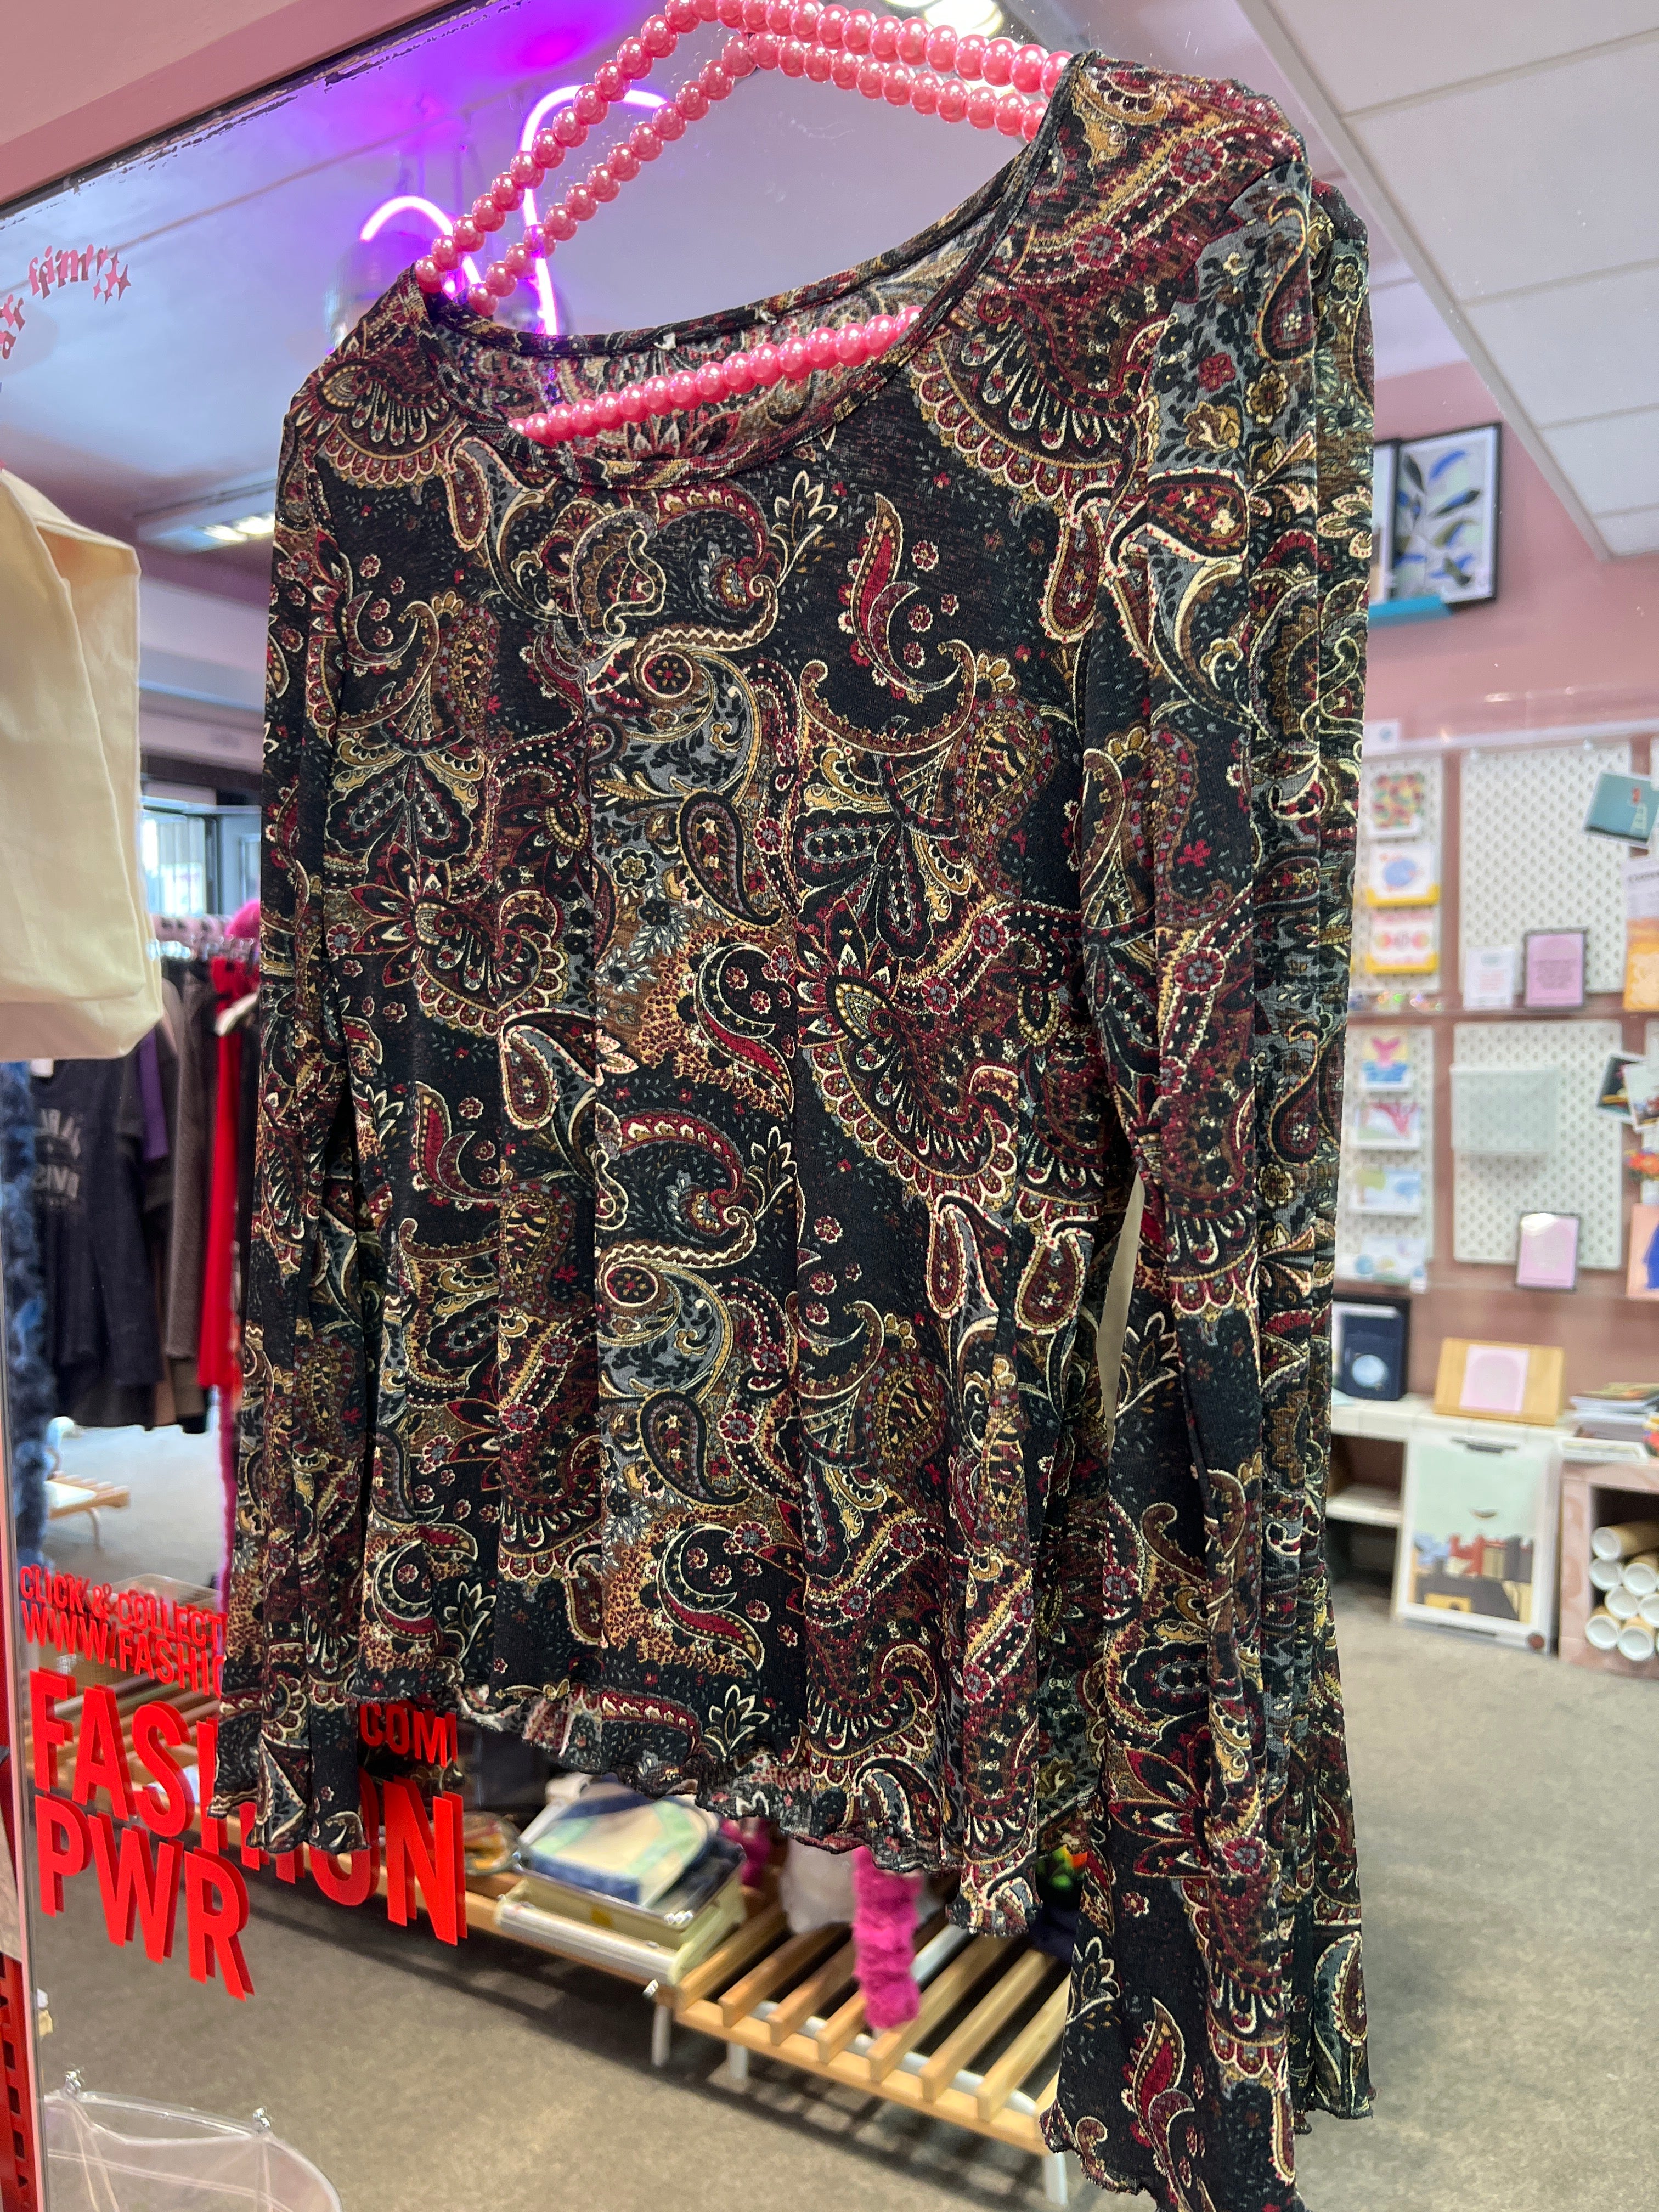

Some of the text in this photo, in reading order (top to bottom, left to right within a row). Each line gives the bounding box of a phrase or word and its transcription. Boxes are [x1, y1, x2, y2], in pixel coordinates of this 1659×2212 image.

[20, 1566, 222, 1652] CLICK & COLLECT
[35, 1795, 246, 2002] PWR
